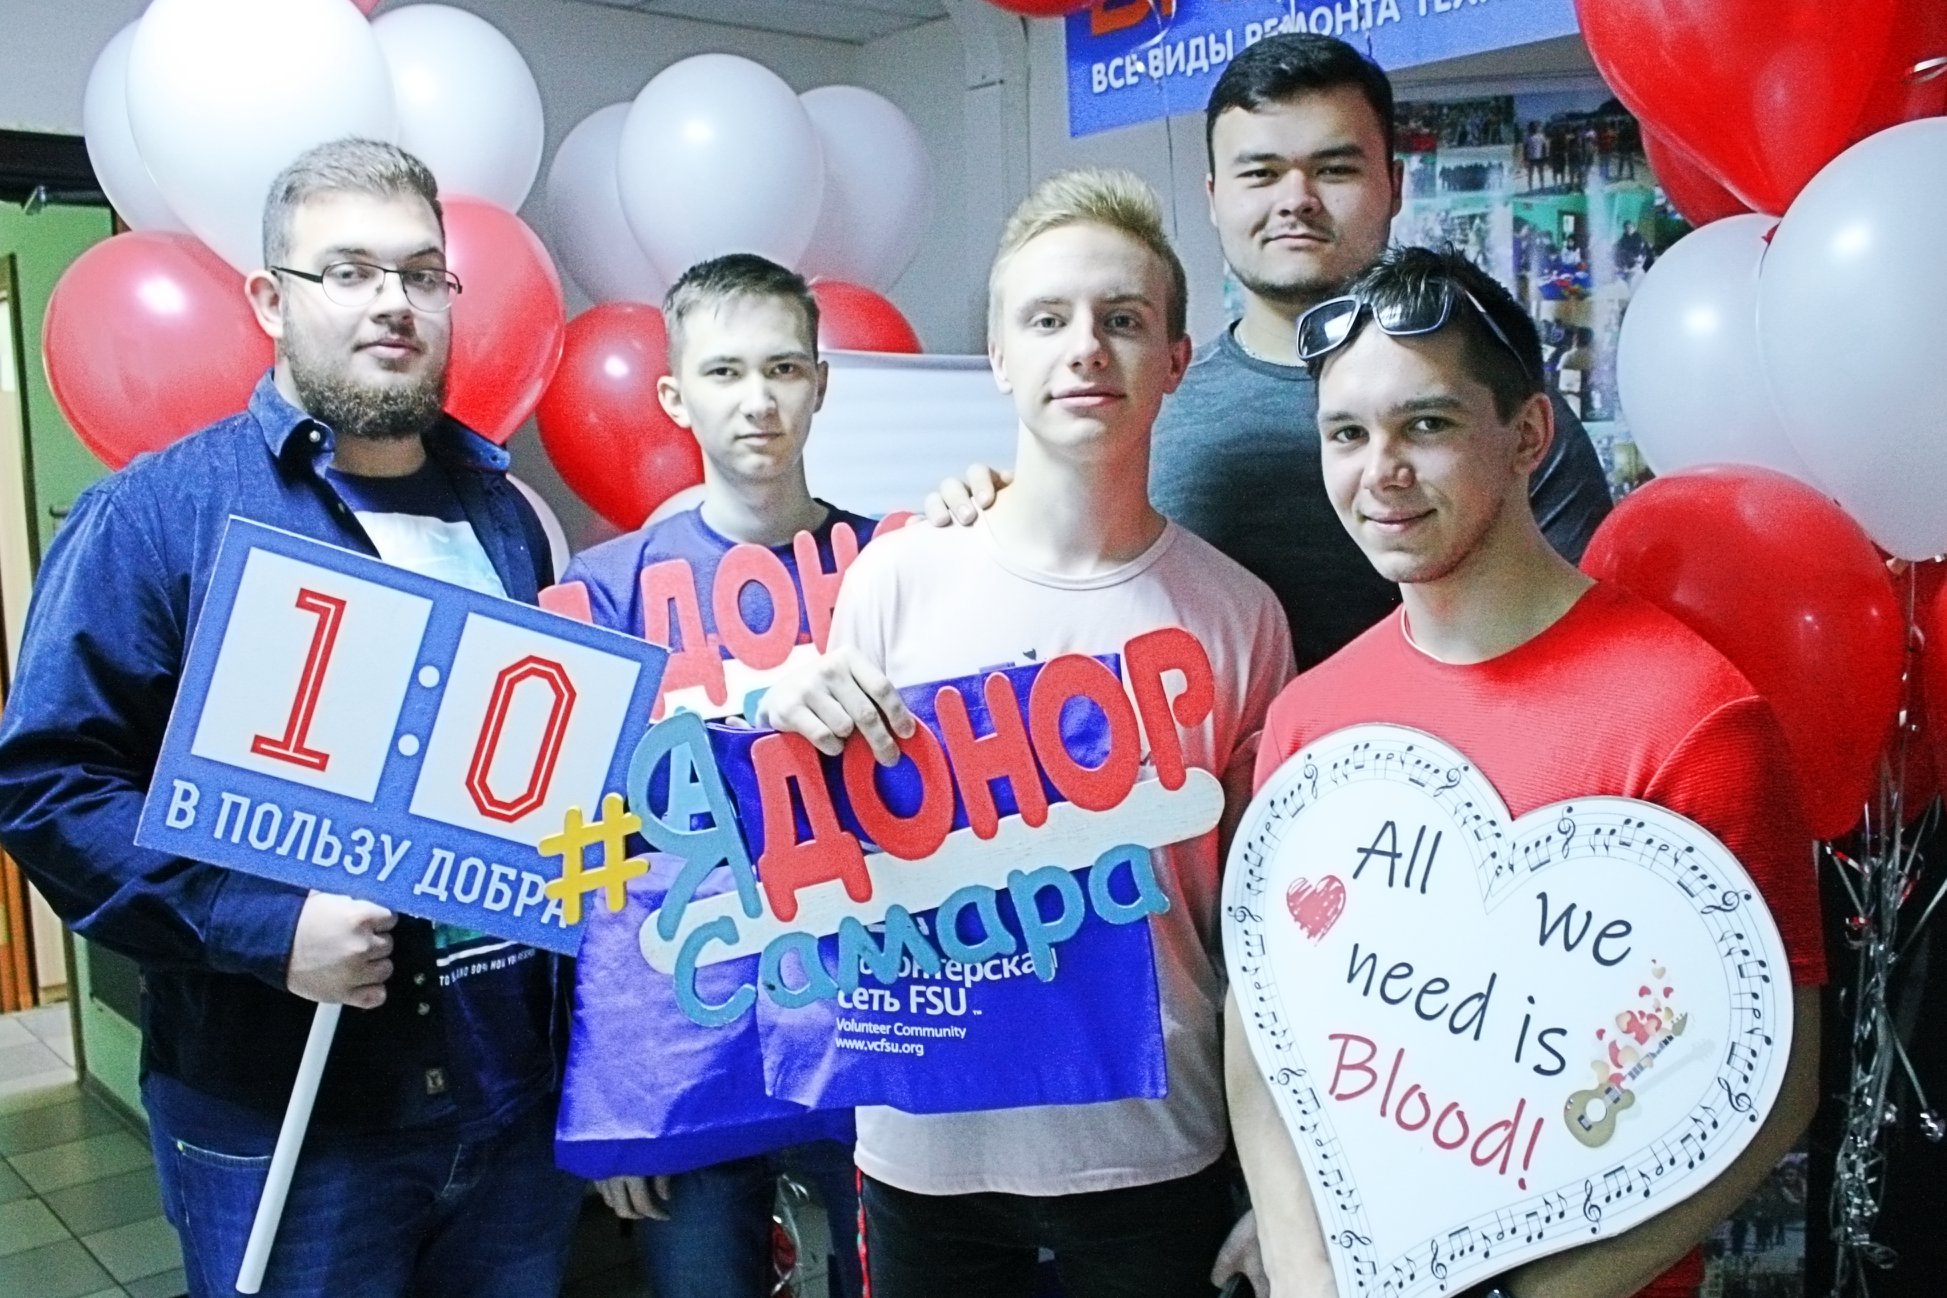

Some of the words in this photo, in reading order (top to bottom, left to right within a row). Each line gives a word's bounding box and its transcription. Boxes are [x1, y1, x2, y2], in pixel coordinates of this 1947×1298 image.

[1091, 52, 1139, 94] ВСЕ
[1148, 28, 1234, 78] ВИДЫ
[1244, 0, 1401, 48] РЕМОНТА
[164, 778, 200, 830] В
[213, 791, 412, 882] ПОЛЬЗУ
[1352, 820, 1443, 895] All
[835, 1035, 925, 1056] www.vcfsu.org
[836, 1017, 891, 1035] Volunteer
[893, 1022, 967, 1039] Community
[1345, 943, 1498, 1042] need
[1514, 995, 1568, 1076] is
[1328, 1033, 1545, 1190] Blood!
